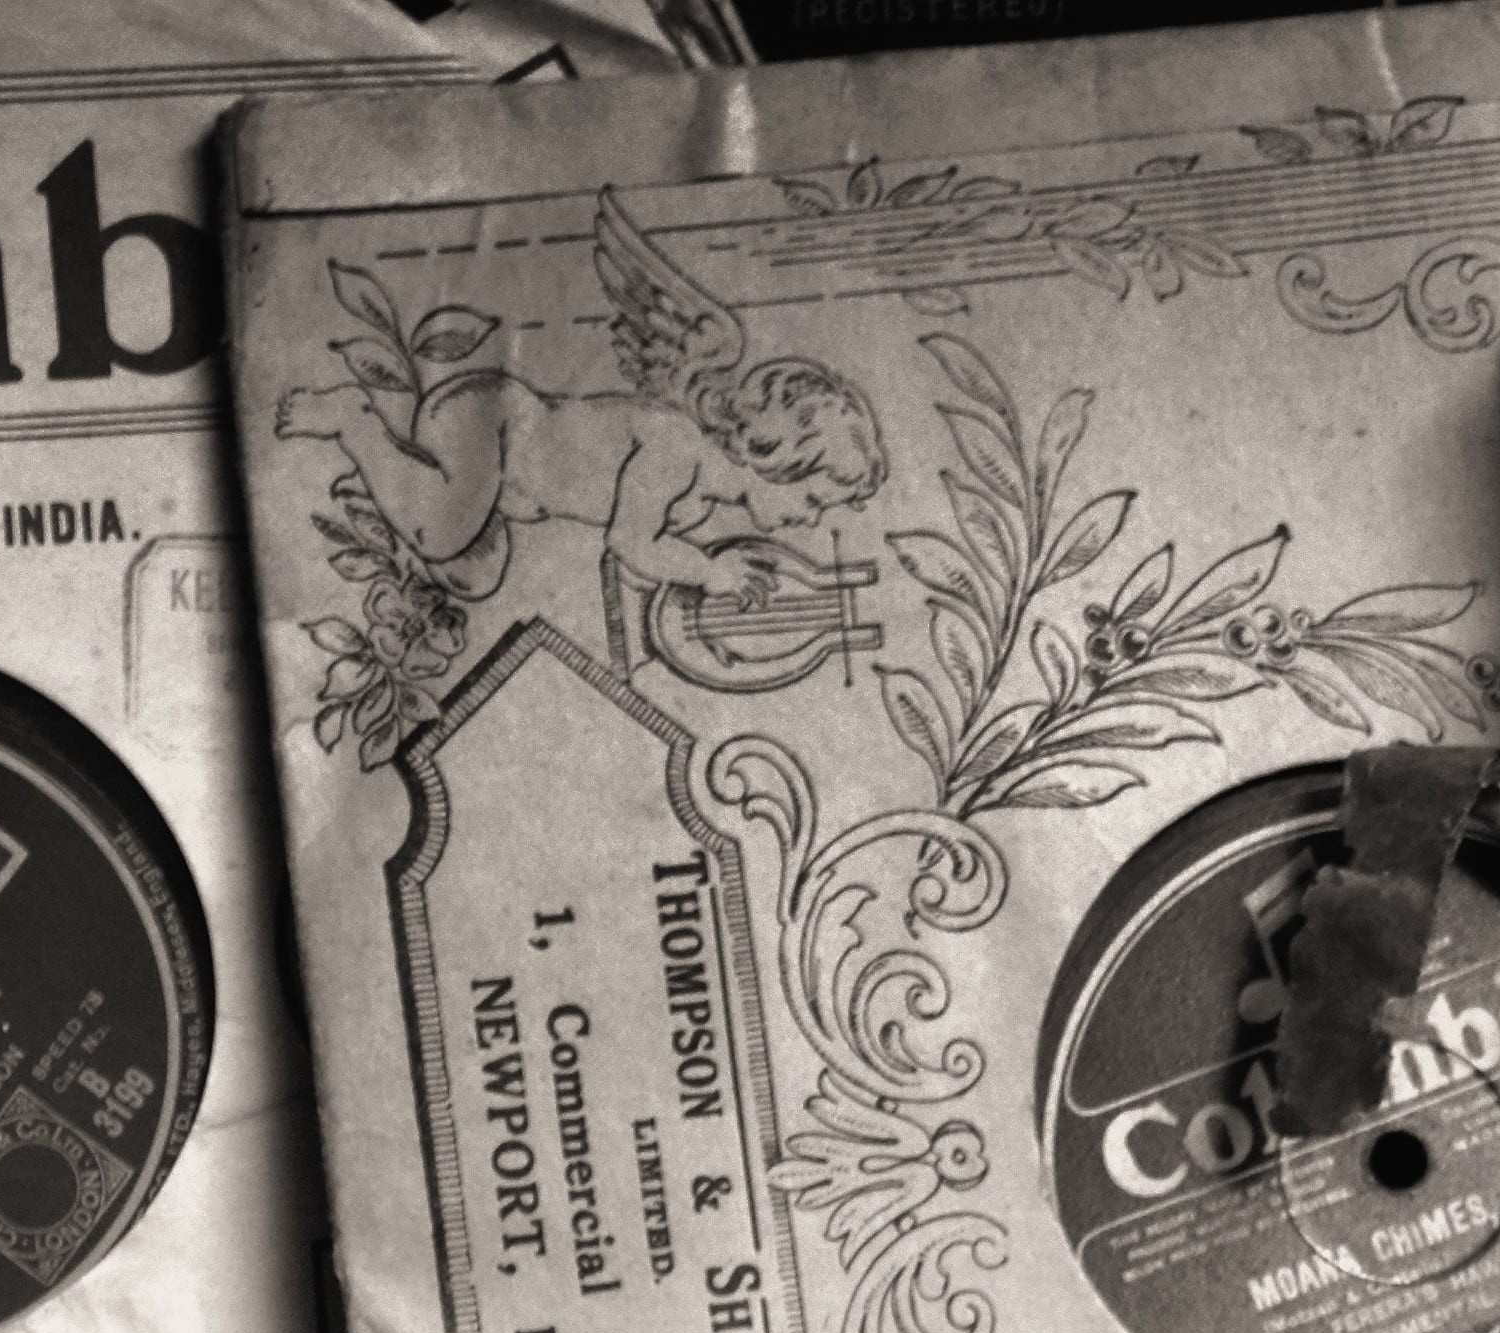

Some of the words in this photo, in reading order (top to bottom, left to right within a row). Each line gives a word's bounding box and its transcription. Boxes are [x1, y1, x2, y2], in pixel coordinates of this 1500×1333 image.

[2, 499, 142, 548] INDIA.
[528, 905, 576, 952] 1,
[30, 1015, 85, 1082] SPEED
[652, 851, 725, 1121] THOMPSON
[691, 1174, 733, 1214] &
[77, 1066, 112, 1100] B
[90, 1064, 158, 1140] 3199
[470, 976, 546, 1277] NEWPORT,
[546, 1004, 622, 1298] Commercial
[35, 1170, 100, 1252] LONDON
[632, 1117, 677, 1286] LIMITED.
[1248, 1245, 1362, 1311] MOANA
